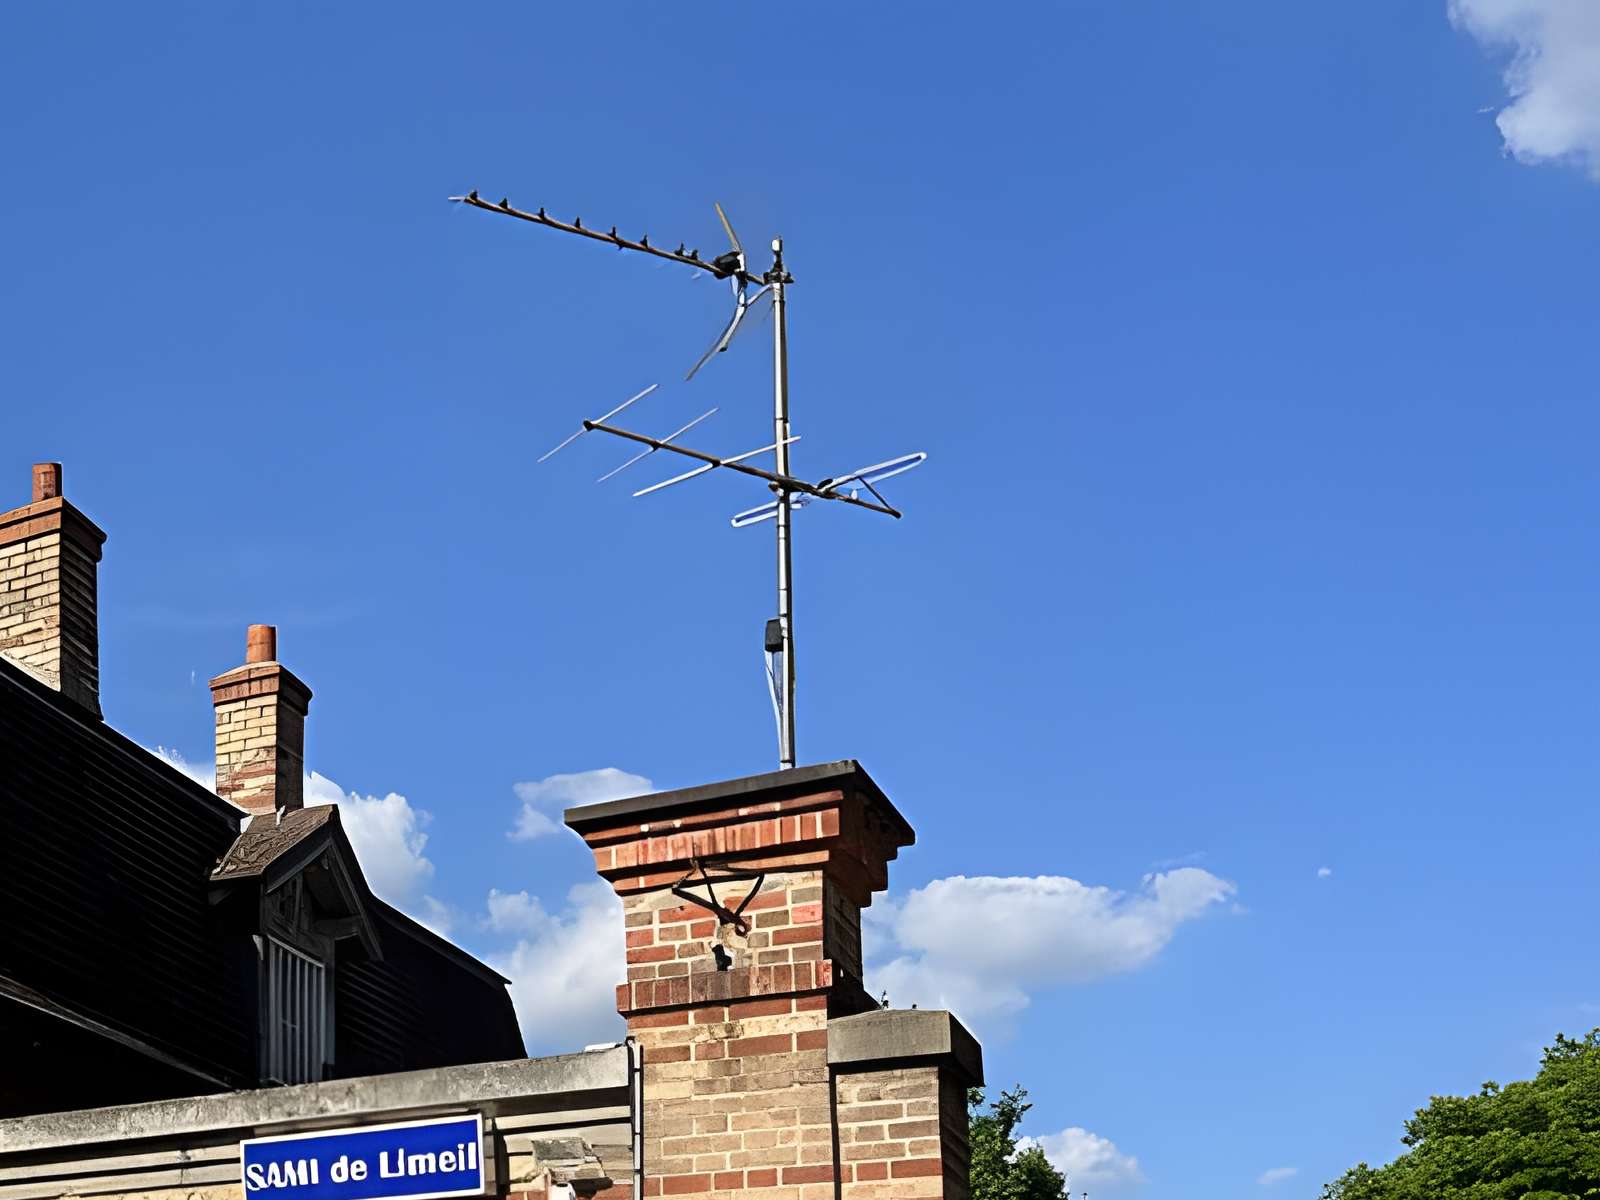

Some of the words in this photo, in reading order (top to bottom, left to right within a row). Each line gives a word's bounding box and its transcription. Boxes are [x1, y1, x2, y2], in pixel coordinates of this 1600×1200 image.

[245, 1158, 320, 1191] SAMI
[330, 1155, 368, 1183] de
[379, 1141, 478, 1179] Limeil
